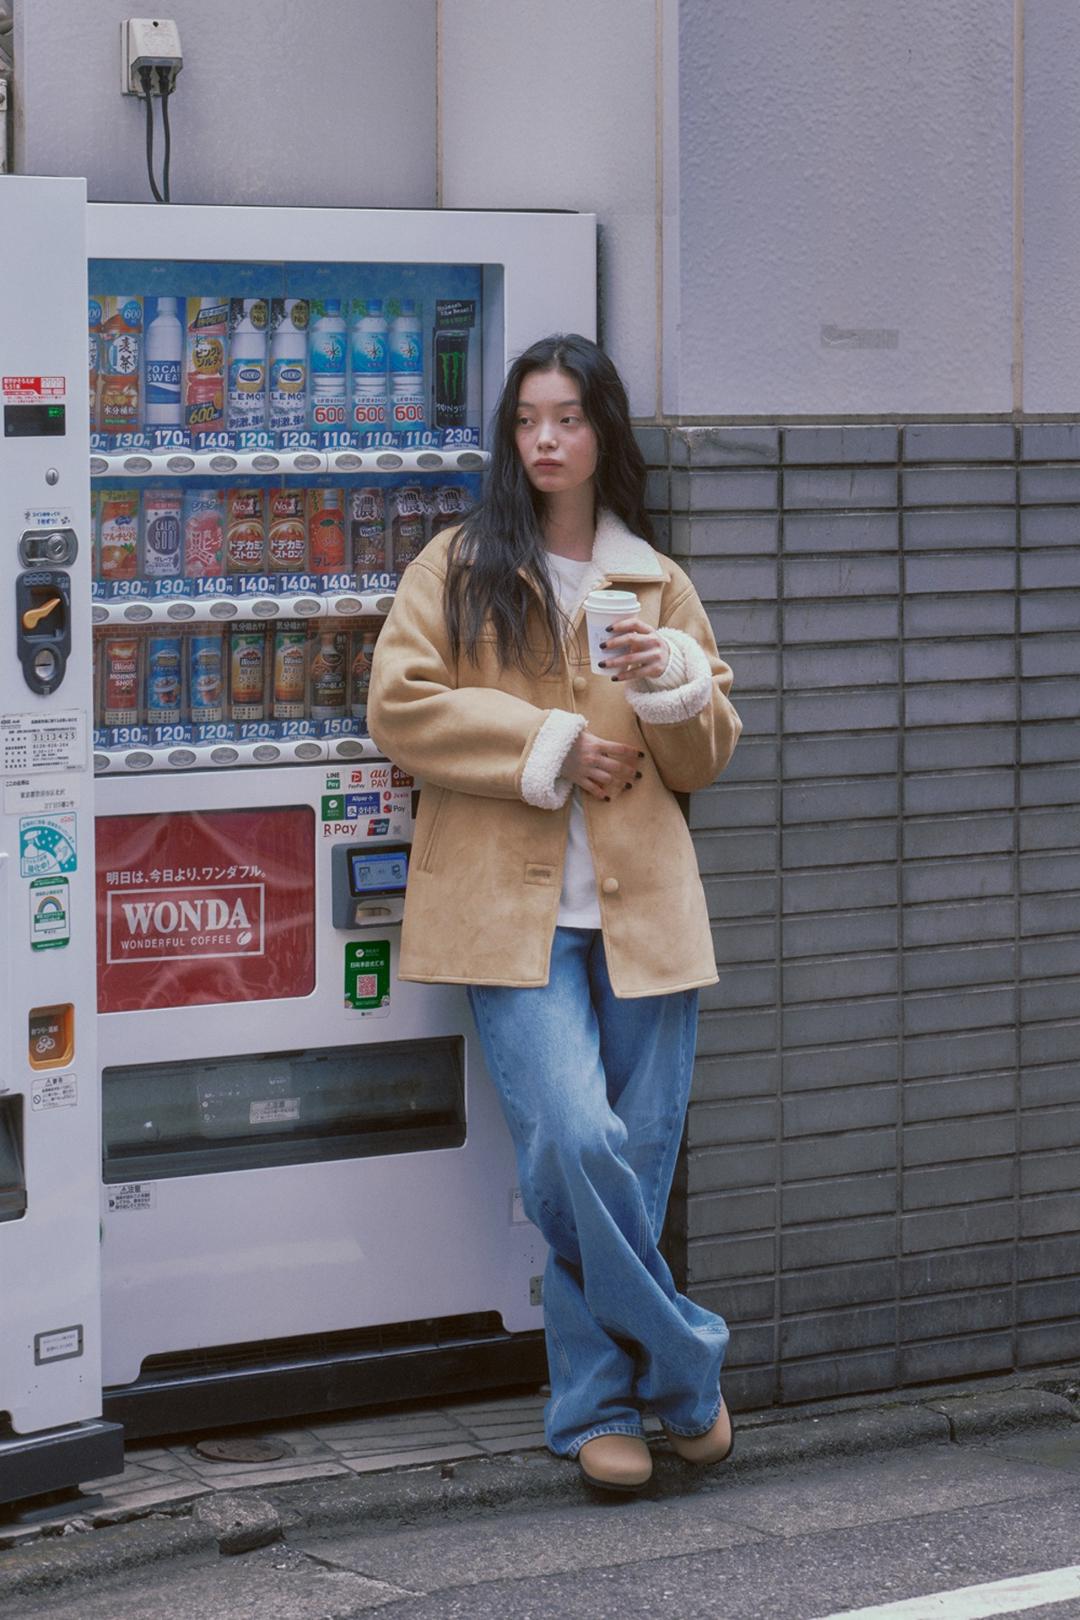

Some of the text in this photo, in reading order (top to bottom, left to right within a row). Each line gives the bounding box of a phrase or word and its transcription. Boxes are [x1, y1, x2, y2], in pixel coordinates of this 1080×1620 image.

[118, 336, 133, 373] 麦茶
[315, 406, 345, 423] 600
[355, 406, 385, 422] 600
[395, 405, 425, 421] 600
[155, 430, 190, 445] 170円
[199, 432, 235, 447] 140円
[240, 432, 274, 447] 120円
[282, 432, 316, 447] 120円
[323, 431, 356, 446] 110円
[366, 431, 398, 446] 110円
[406, 431, 438, 445] 110円
[445, 428, 478, 443] 230円
[112, 580, 148, 594] 130円
[154, 579, 190, 594] 130円
[197, 577, 233, 593] 140円
[239, 577, 275, 592] 140円
[281, 575, 317, 591] 140円
[322, 575, 356, 590] 140円
[362, 574, 397, 589] 140円
[155, 726, 191, 741] 120円
[199, 725, 233, 739] 120円
[241, 723, 275, 737] 120円
[281, 721, 316, 735] 120円
[323, 719, 358, 734] 150円
[111, 728, 148, 743] 130円
[326, 771, 340, 779] LINE
[370, 769, 390, 778] au
[327, 780, 339, 789] Pay
[371, 778, 388, 789] PAY
[393, 804, 405, 813] Pay
[323, 823, 331, 836] R
[334, 823, 357, 837] Pay
[106, 865, 267, 885] 明日は、今日より、ワンダフル。
[121, 897, 251, 935] WONDA
[121, 934, 232, 950] WONDERFUL COFFEE
